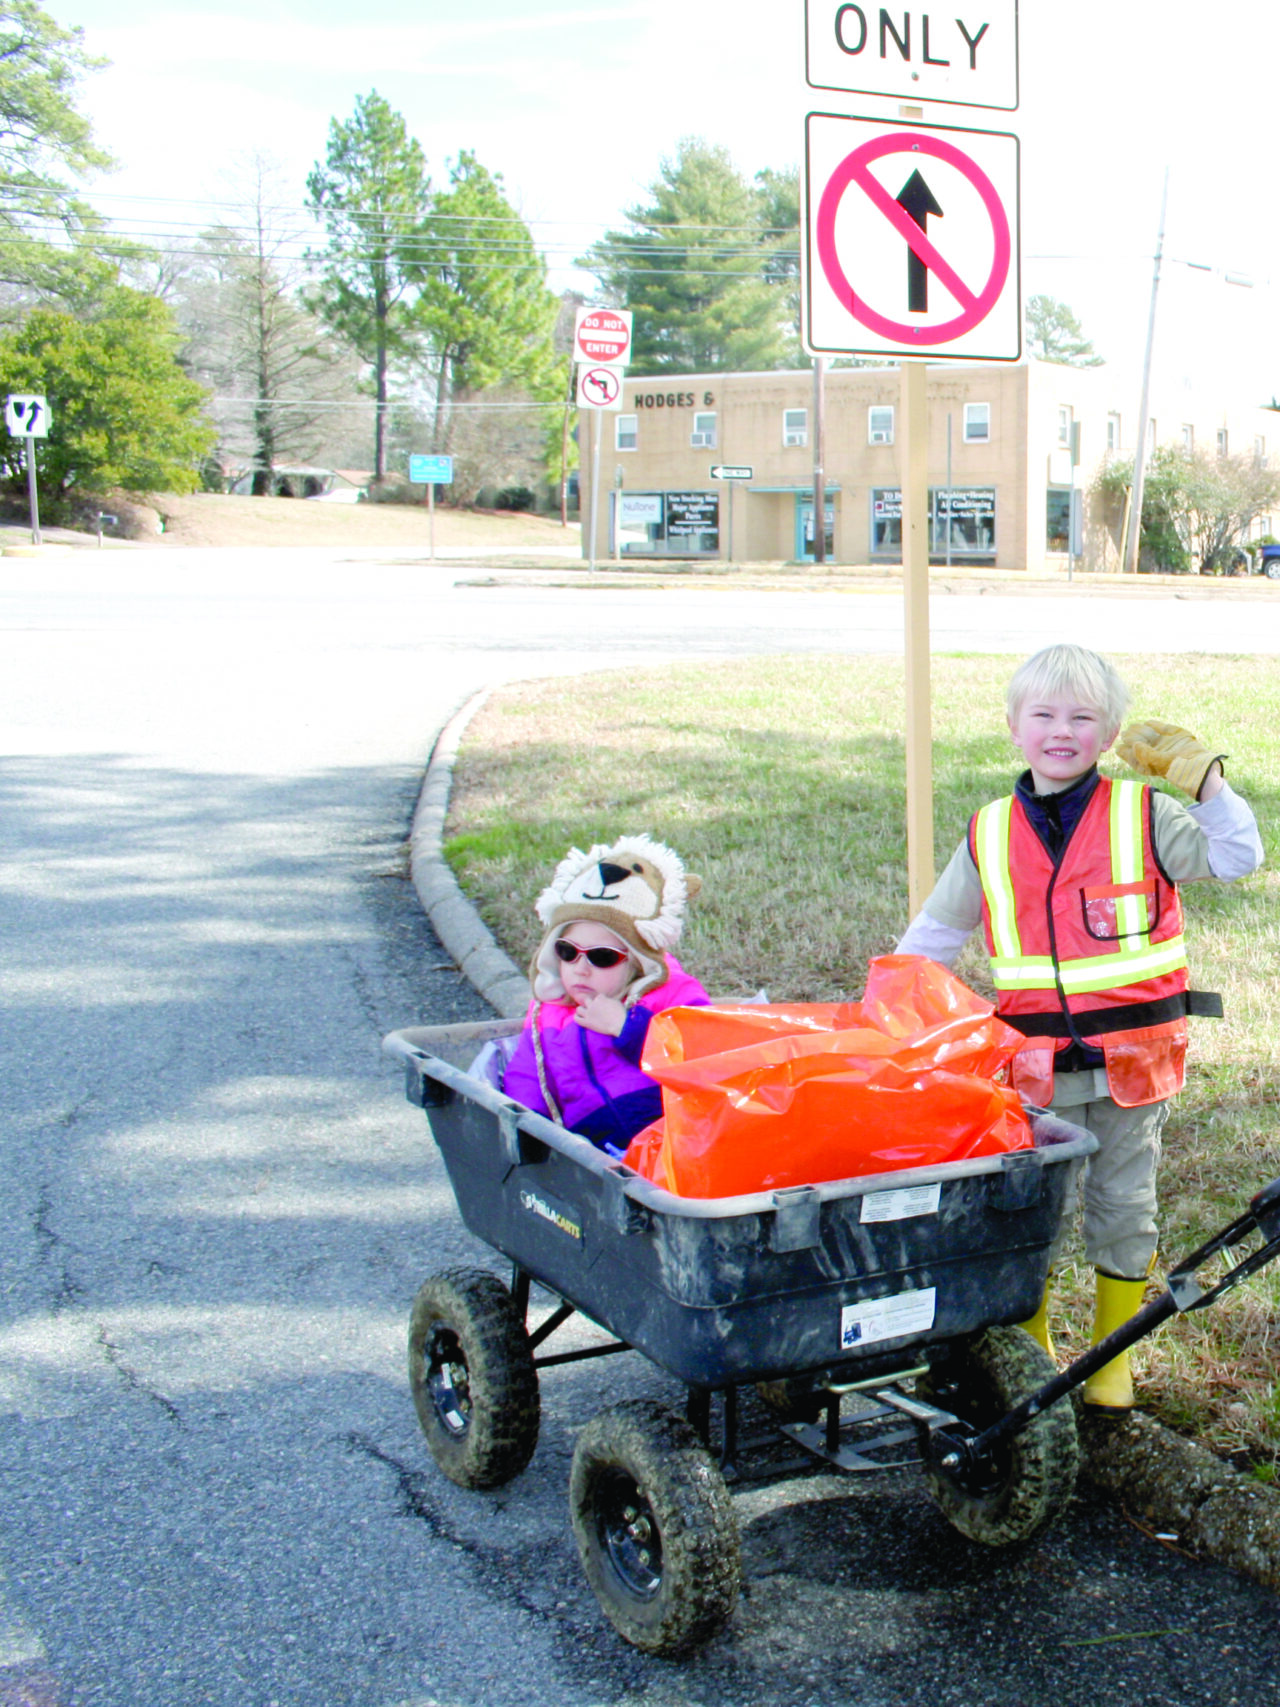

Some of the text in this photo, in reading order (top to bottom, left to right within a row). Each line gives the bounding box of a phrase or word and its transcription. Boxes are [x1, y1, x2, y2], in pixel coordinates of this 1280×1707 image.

[835, 2, 990, 70] ONLY
[585, 318, 623, 329] DO NOT
[586, 343, 619, 354] ENTER
[634, 391, 714, 408] HODGES &
